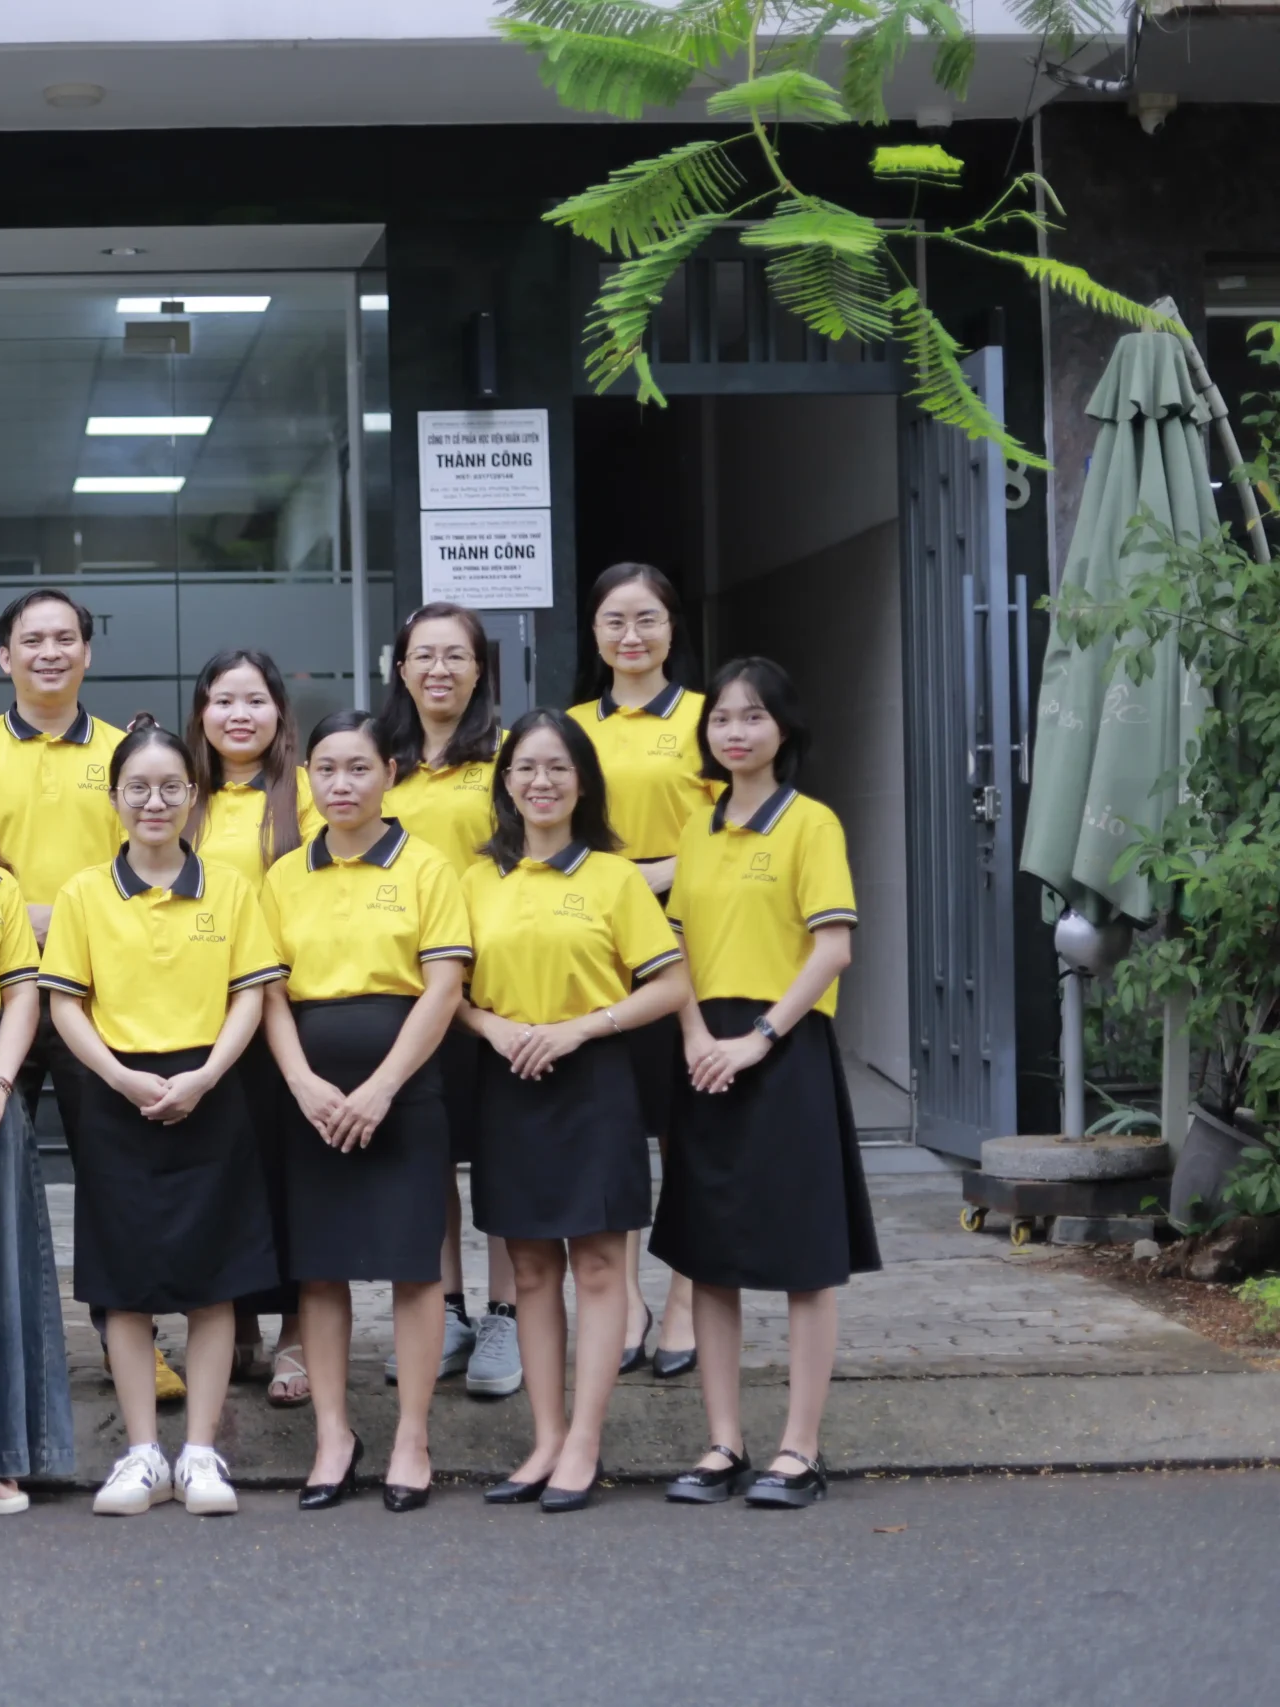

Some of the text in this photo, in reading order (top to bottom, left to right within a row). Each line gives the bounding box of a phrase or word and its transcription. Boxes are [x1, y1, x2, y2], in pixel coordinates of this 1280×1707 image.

[436, 449, 533, 469] THÀNH CÔNG
[439, 541, 535, 561] THÀNH CÔNG
[77, 782, 93, 790] VAR
[366, 902, 381, 910] VAR
[552, 908, 569, 916] VAR
[188, 934, 226, 942] VAR eCOM
